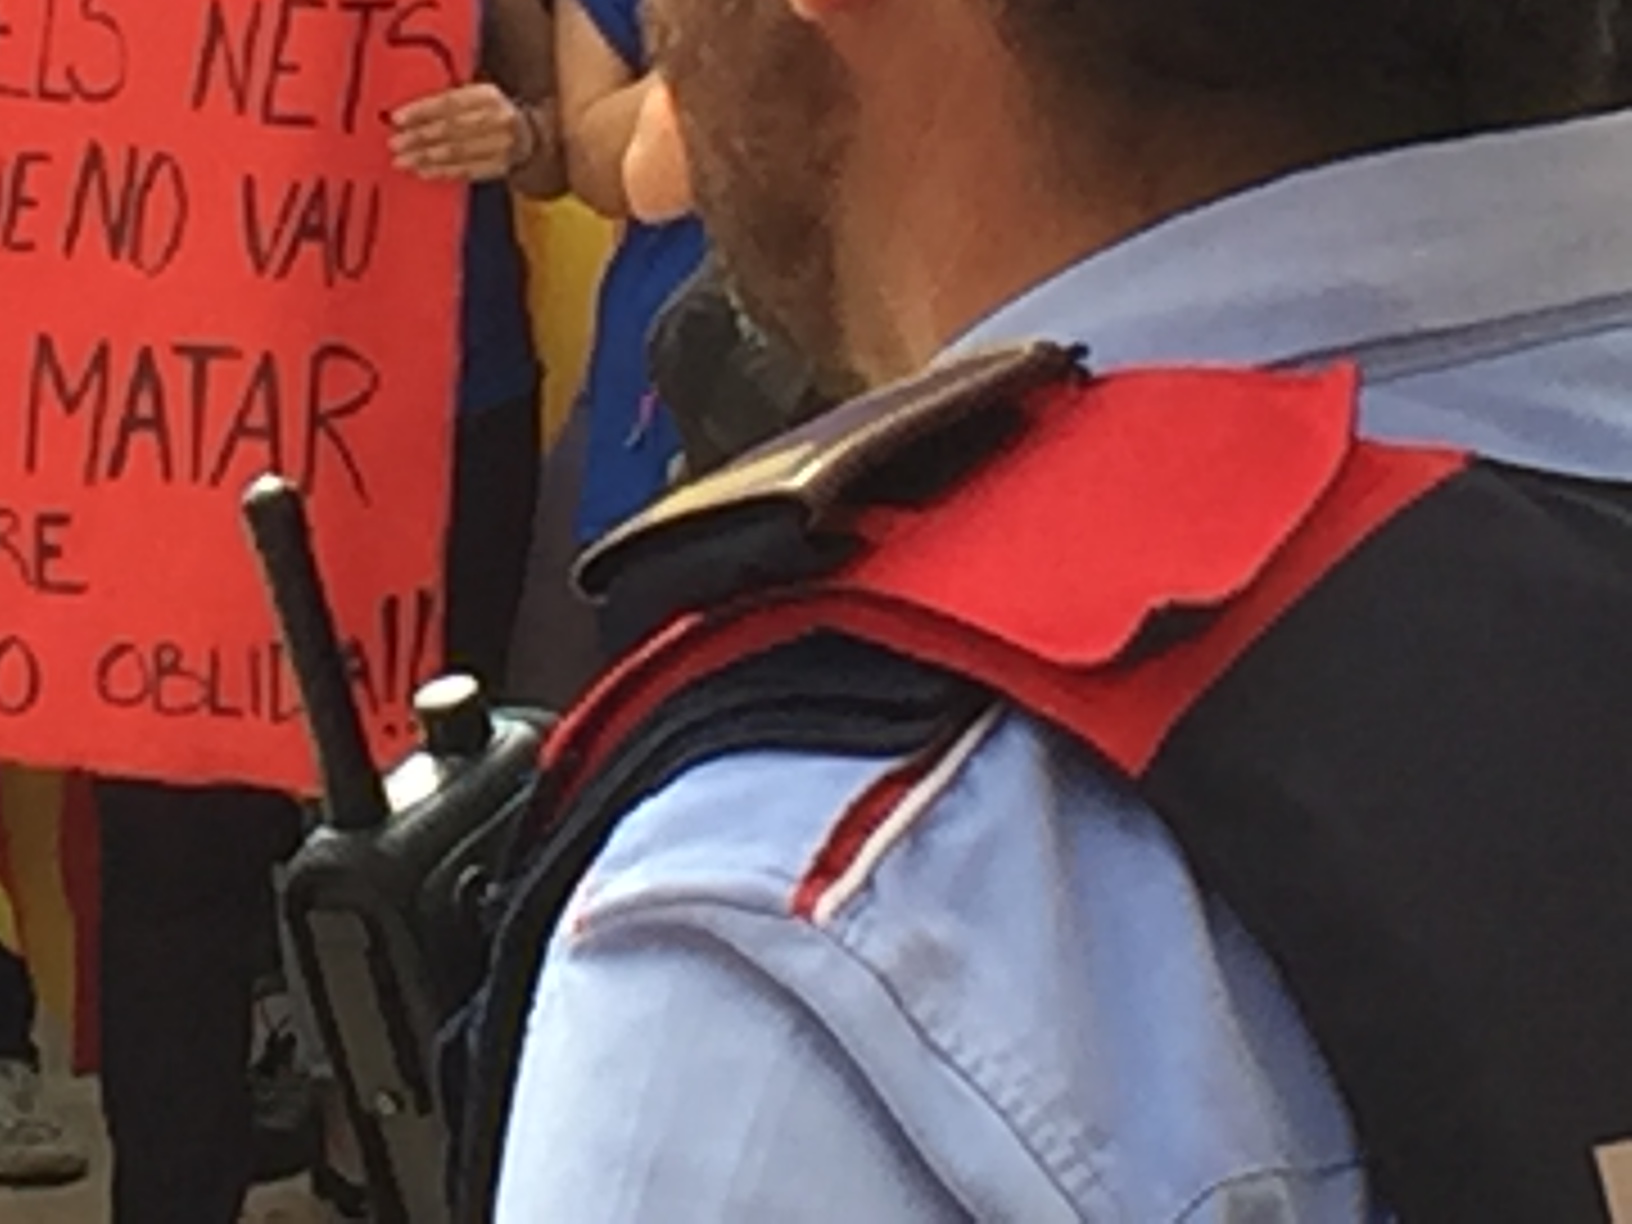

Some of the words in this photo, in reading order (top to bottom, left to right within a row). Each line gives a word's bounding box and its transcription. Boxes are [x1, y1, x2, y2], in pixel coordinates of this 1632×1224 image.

[64, 141, 190, 278] NO
[242, 176, 382, 288] VAU
[25, 332, 382, 510] MATAR
